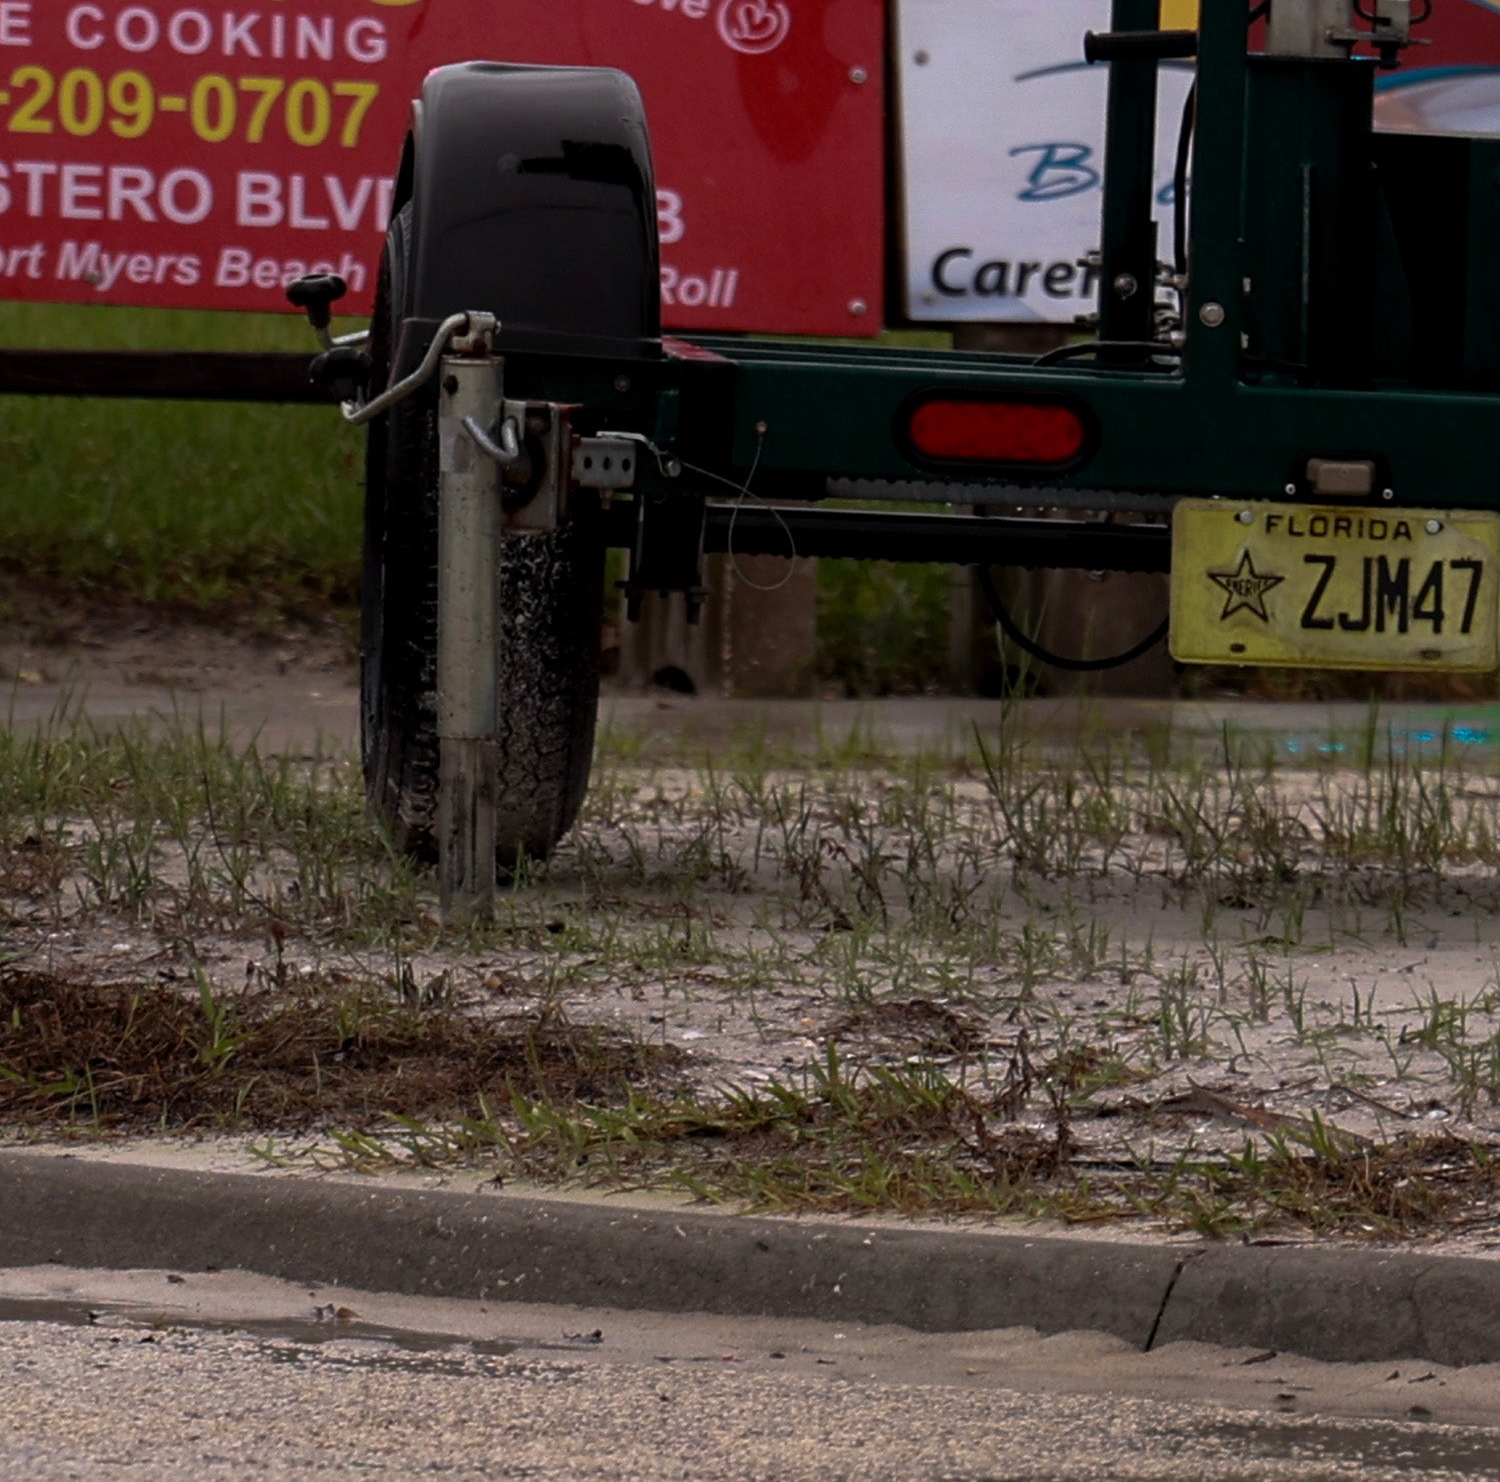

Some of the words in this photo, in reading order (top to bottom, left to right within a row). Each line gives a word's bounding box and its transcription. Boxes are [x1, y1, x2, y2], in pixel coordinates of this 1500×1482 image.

[66, 3, 389, 63] COOKING
[57, 241, 201, 291] Myers
[1264, 513, 1414, 542] FLORIDA
[1299, 552, 1484, 635] ZJM47
